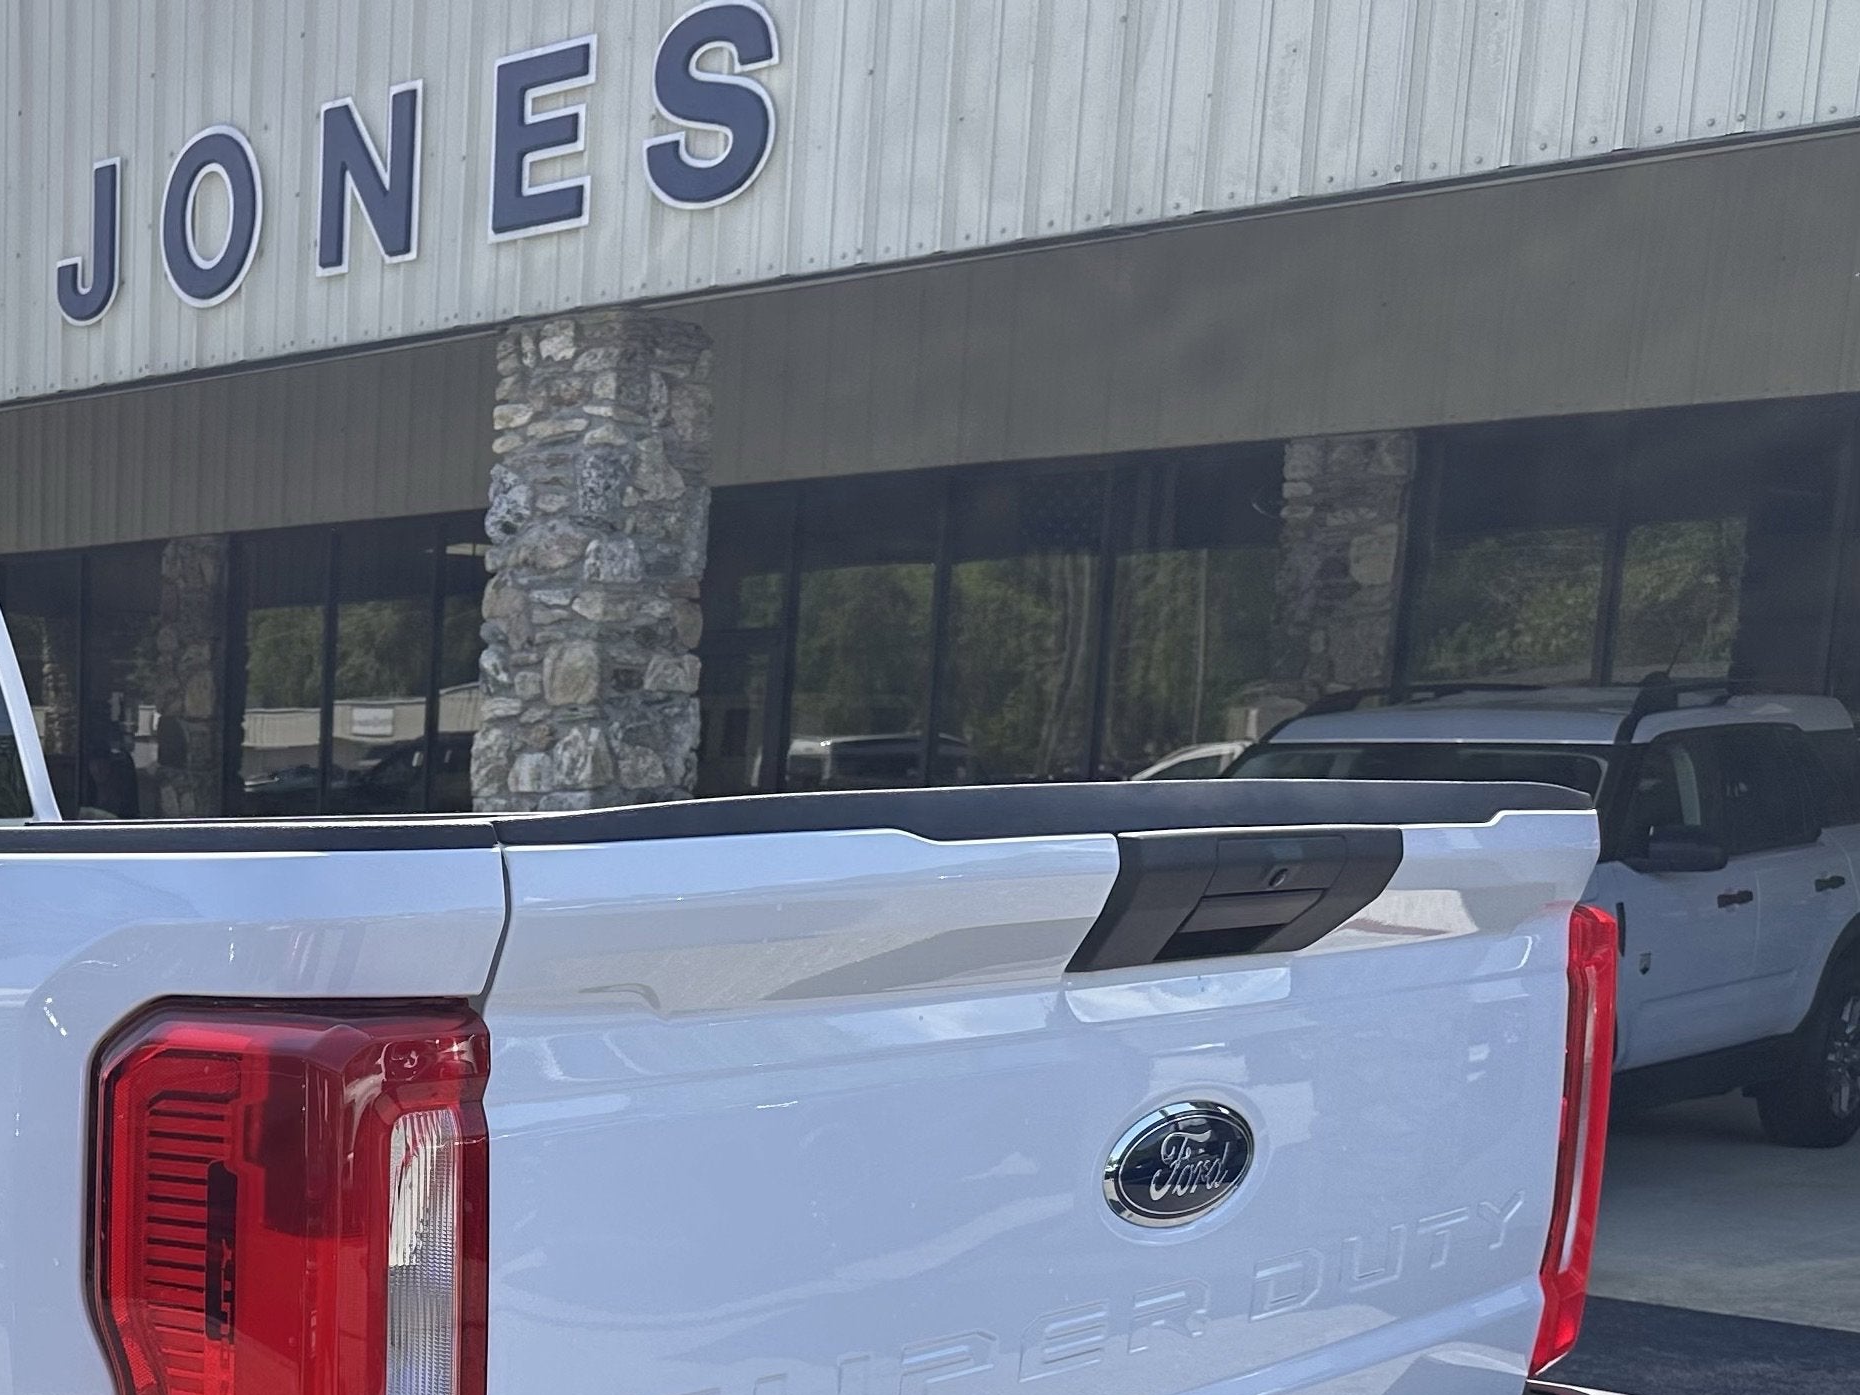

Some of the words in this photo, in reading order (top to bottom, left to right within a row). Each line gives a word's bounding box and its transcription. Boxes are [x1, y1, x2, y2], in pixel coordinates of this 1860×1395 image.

[56, 0, 780, 327] JONES
[1149, 1130, 1229, 1201] Ford
[1250, 1190, 1526, 1323] DUTY
